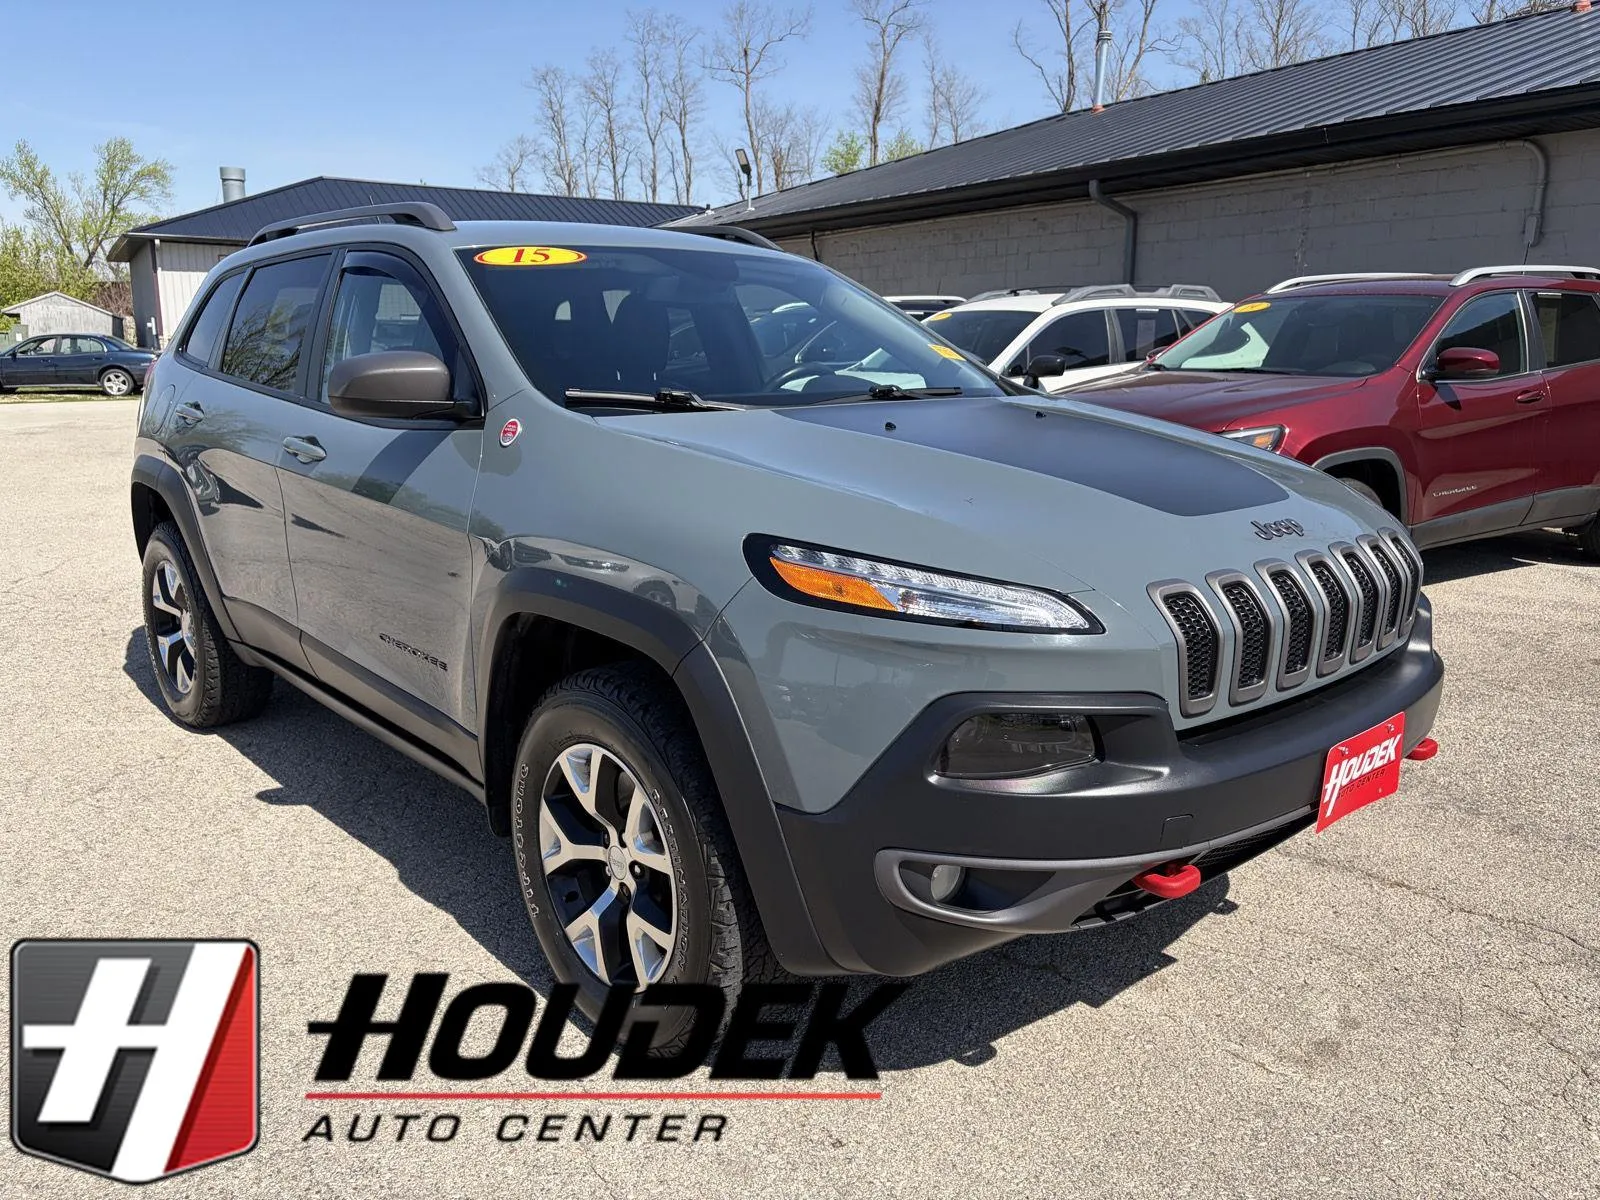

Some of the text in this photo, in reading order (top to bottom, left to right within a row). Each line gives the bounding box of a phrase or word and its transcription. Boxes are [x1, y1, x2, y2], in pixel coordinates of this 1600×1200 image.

[509, 248, 551, 263] 15
[1250, 518, 1304, 540] Jeep
[379, 632, 448, 672] CHEROKEE
[1323, 733, 1402, 818] HOUDEK
[1356, 768, 1386, 788] CENTER
